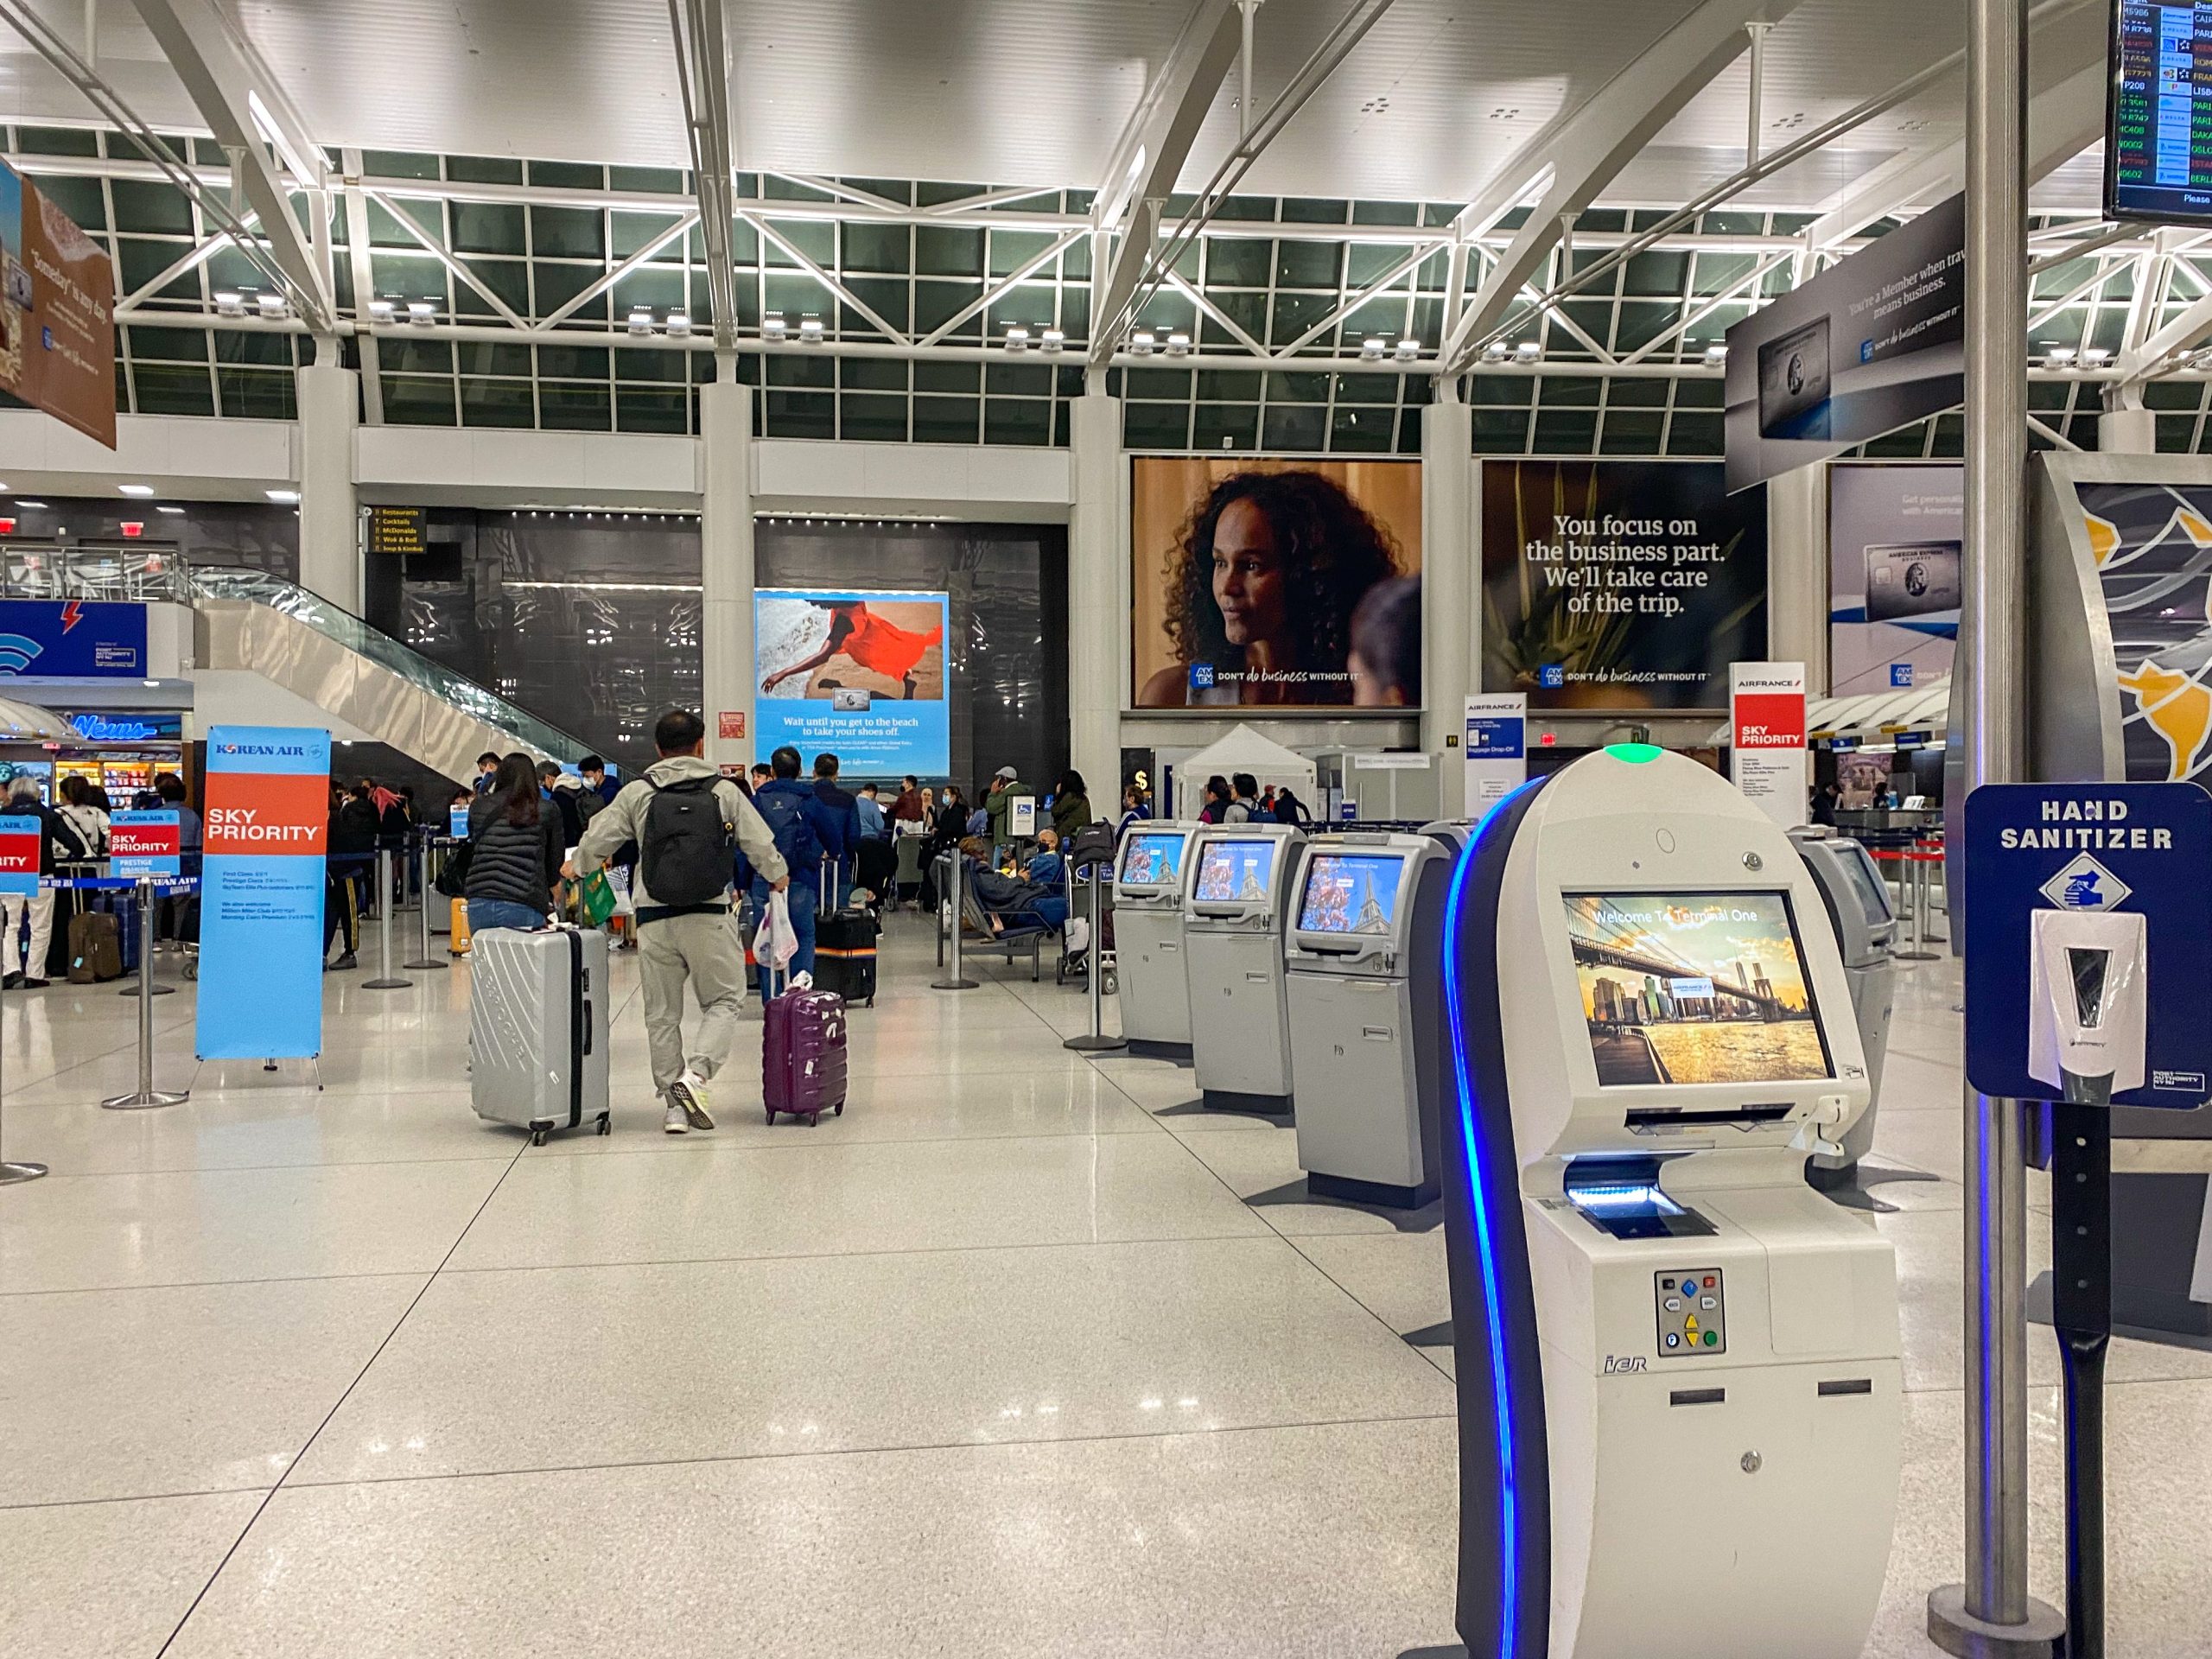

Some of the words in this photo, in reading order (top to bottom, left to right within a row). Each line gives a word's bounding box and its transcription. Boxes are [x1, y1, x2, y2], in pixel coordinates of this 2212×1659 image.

[2184, 194, 2210, 204] Please
[1849, 295, 1874, 316] You're
[1875, 292, 1881, 303] a
[1882, 273, 1918, 300] Member
[1920, 259, 1946, 280] when
[1873, 298, 1903, 321] means
[1904, 276, 1946, 305] business.
[1554, 515, 1597, 536] You
[1603, 515, 1663, 536] focus
[1669, 518, 1698, 536] on
[1526, 540, 1563, 562] the
[1569, 541, 1668, 562] business
[1673, 543, 1726, 566] part.
[1543, 567, 1600, 587] We'll
[1606, 567, 1656, 588] take
[1660, 571, 1708, 588] care
[1567, 592, 1590, 613] of
[1596, 593, 1633, 613] the
[1638, 593, 1685, 617] trip.
[1218, 672, 1244, 681] DON'T
[1246, 666, 1259, 683] do
[1262, 667, 1307, 682] business
[1309, 672, 1348, 681] WITHOUT
[1350, 672, 1358, 681] IT
[1567, 672, 1593, 681] DON'T
[1595, 666, 1608, 683] do
[1611, 667, 1656, 683] business
[1657, 672, 1695, 681] WITHOUT
[1698, 672, 1707, 681] IT
[73, 715, 157, 739] News
[784, 717, 804, 726] Wait
[806, 717, 828, 726] until
[830, 719, 847, 728] you
[849, 718, 862, 728] get
[876, 717, 891, 726] the
[893, 717, 918, 727] beach
[1742, 726, 1768, 734] SKY
[803, 727, 812, 735] to
[814, 727, 833, 735] take
[836, 728, 856, 737] your
[858, 727, 883, 735] shoes
[886, 727, 899, 736] off.
[1742, 734, 1800, 745] PRIORITY
[216, 744, 274, 756] KOREAN
[276, 746, 304, 756] AIR
[208, 809, 257, 823] SKY
[2042, 800, 2128, 821] HAND
[112, 835, 137, 843] SKY
[208, 824, 318, 841] PRIORITY
[2001, 828, 2172, 849] SANITIZER
[111, 843, 169, 852] PRIORITY
[1593, 910, 1652, 924] Welcome
[1675, 910, 1728, 923] Terminal
[1732, 910, 1758, 922] One
